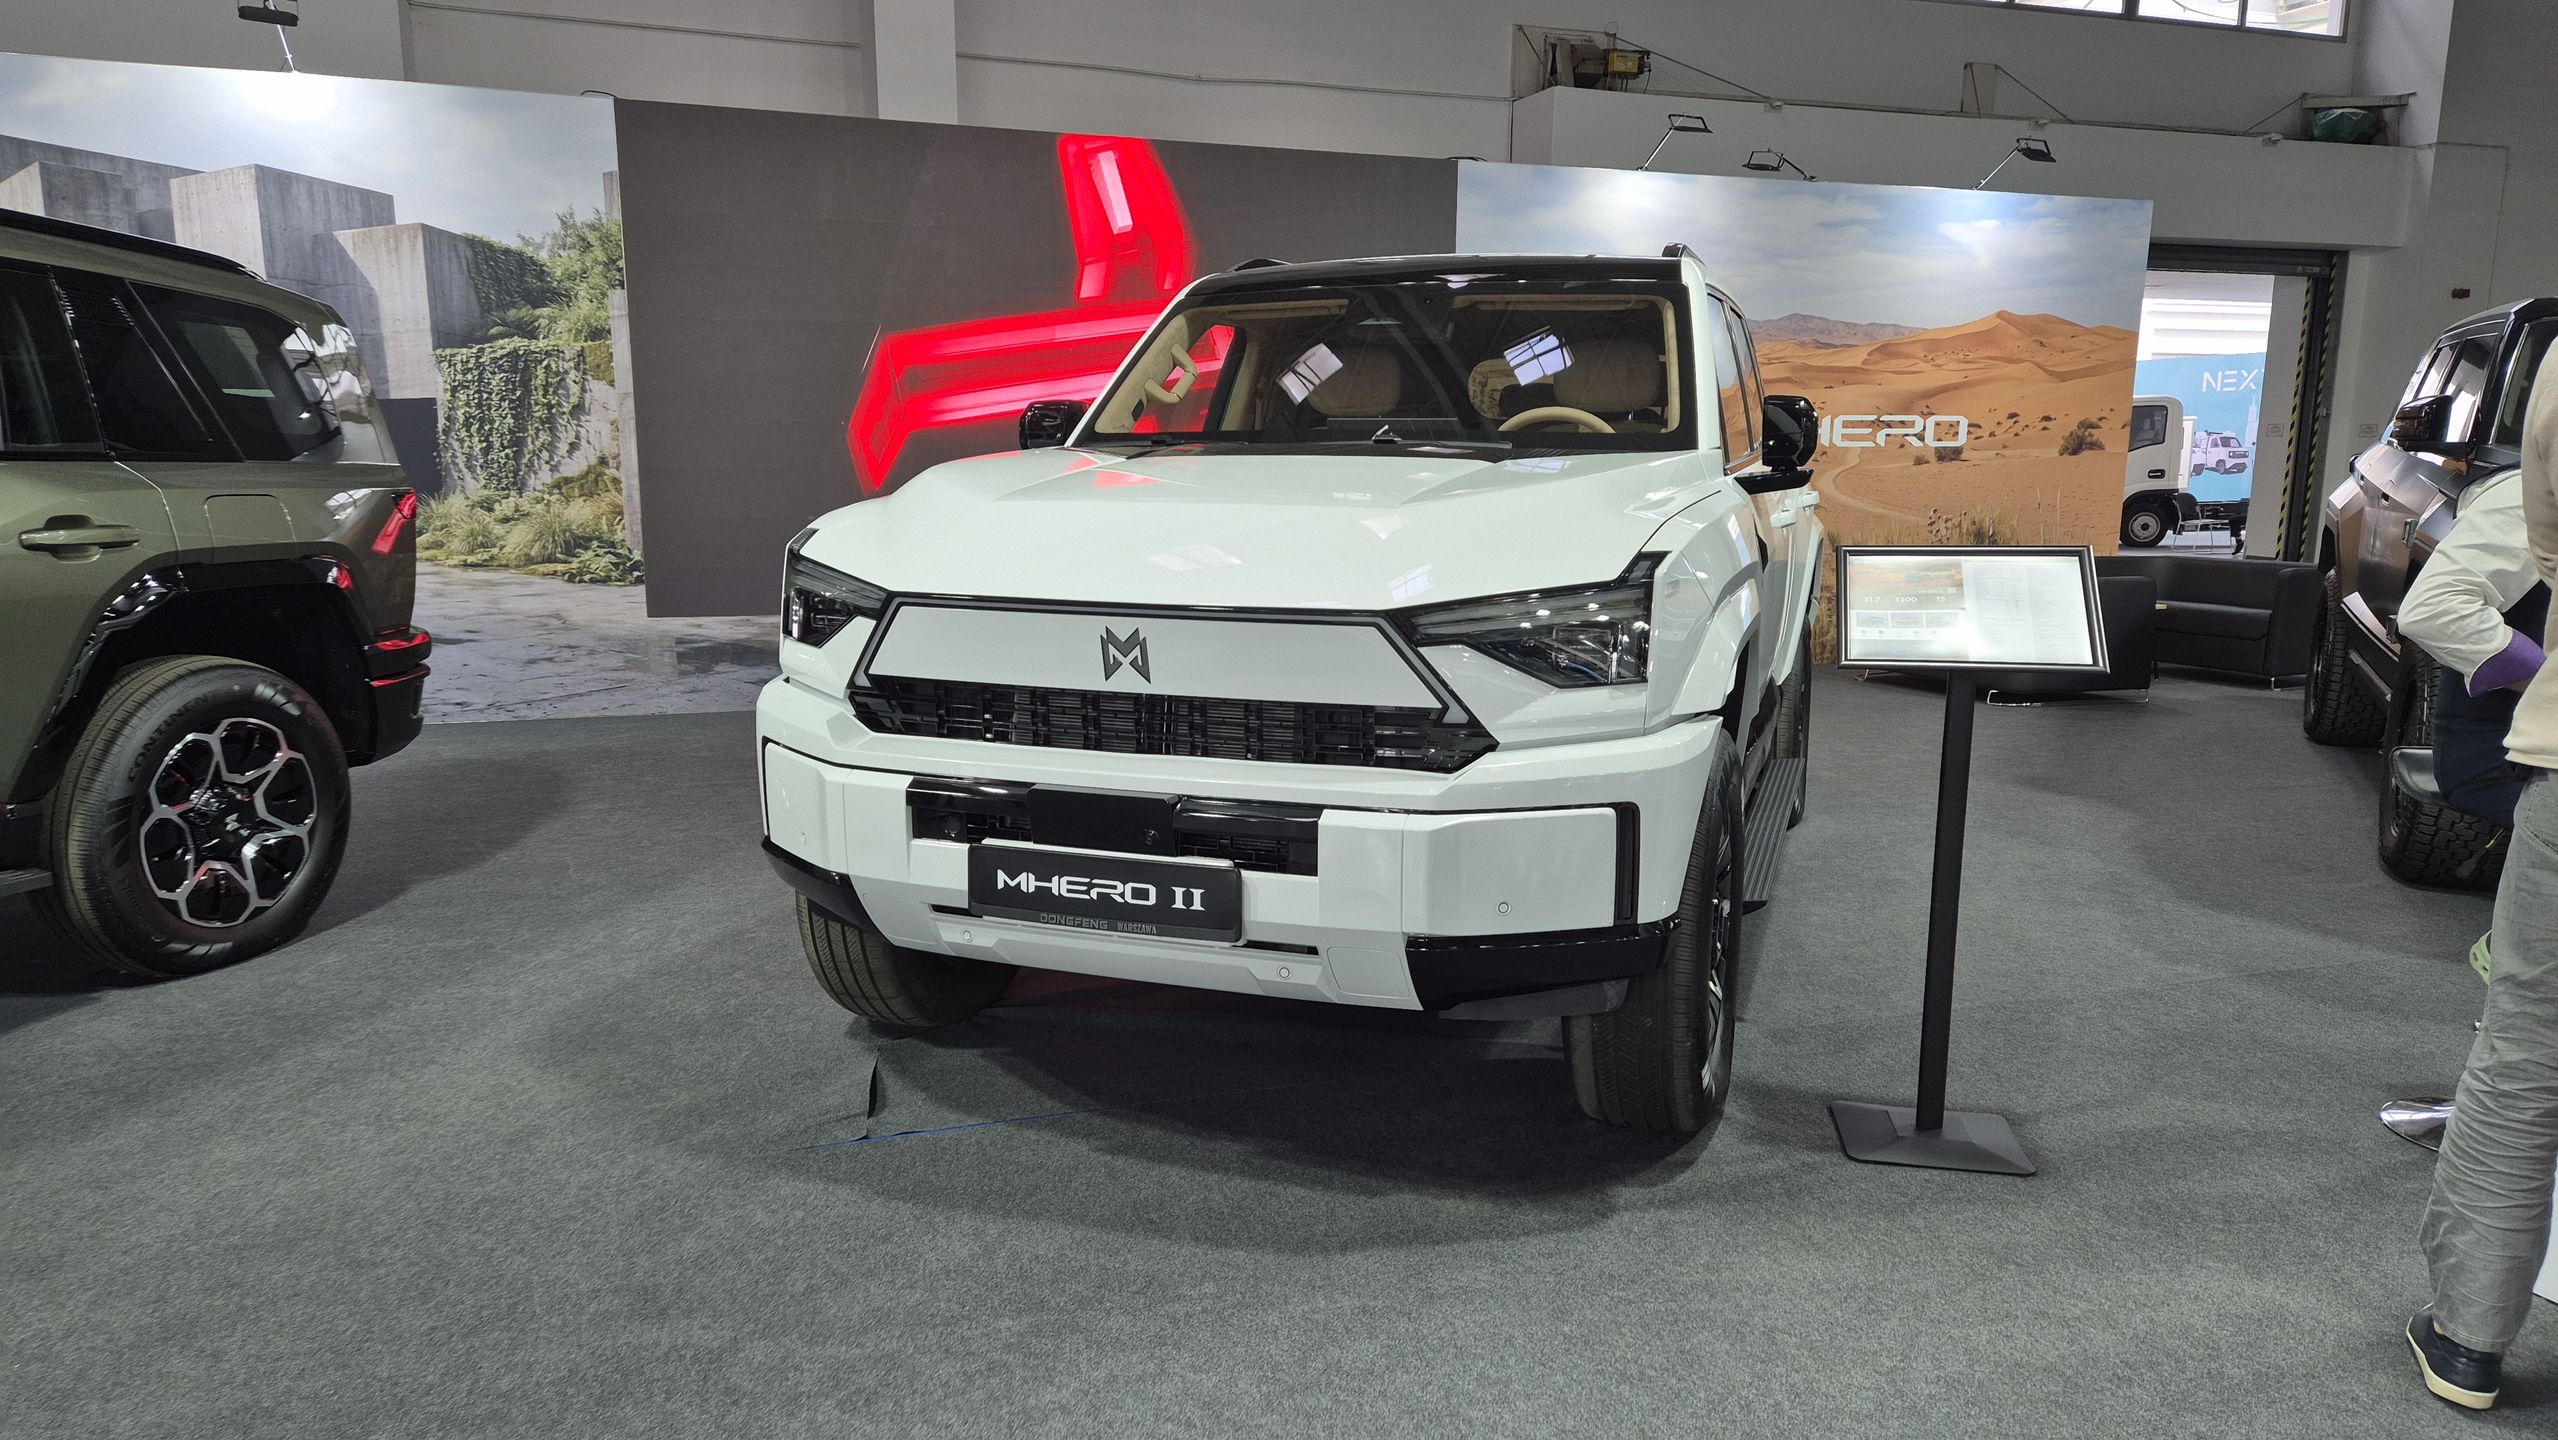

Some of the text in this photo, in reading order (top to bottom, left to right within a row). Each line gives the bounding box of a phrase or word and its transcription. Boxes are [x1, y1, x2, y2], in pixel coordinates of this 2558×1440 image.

[2202, 369, 2264, 392] NEX
[997, 868, 1206, 911] MHERO II
[1040, 913, 1158, 935] DONGFENG WARSZAWA
